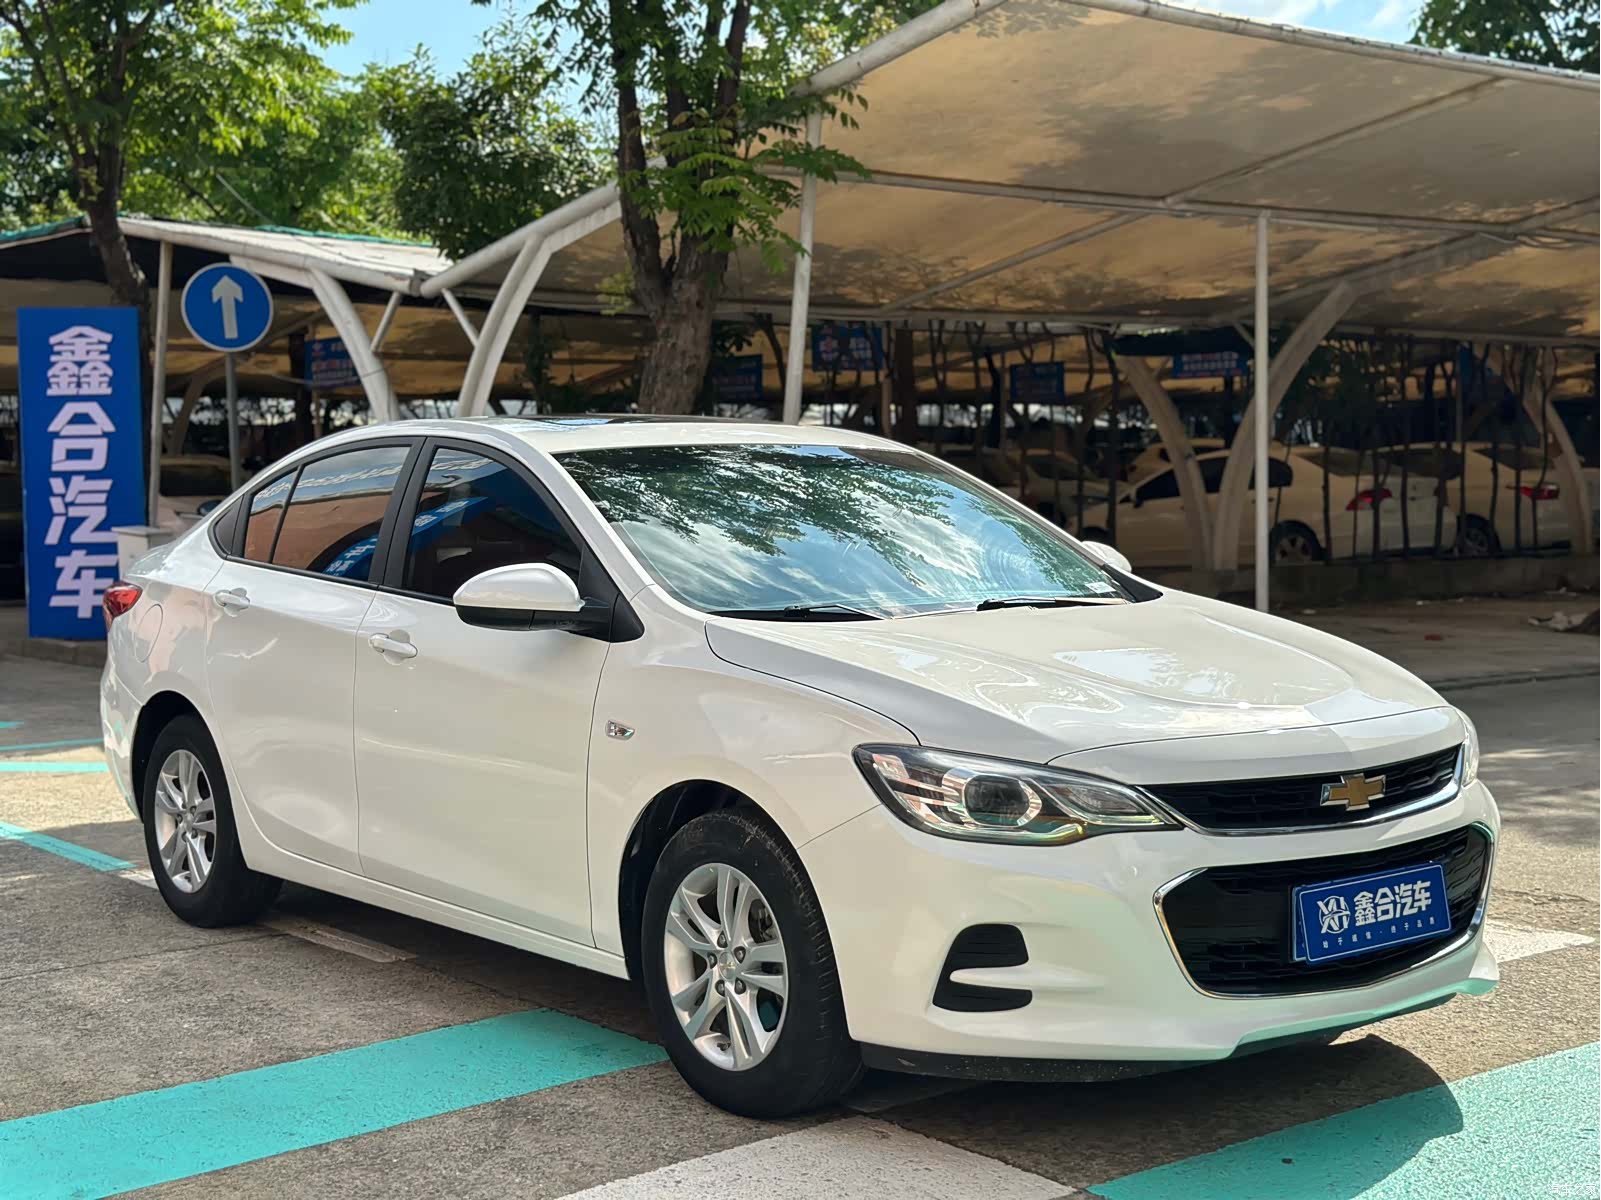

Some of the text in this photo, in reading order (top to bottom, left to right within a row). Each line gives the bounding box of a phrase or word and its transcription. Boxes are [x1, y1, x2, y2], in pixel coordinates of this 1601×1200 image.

[44, 325, 119, 619] 鑫合汽车
[1354, 880, 1432, 926] 鑫合汽车
